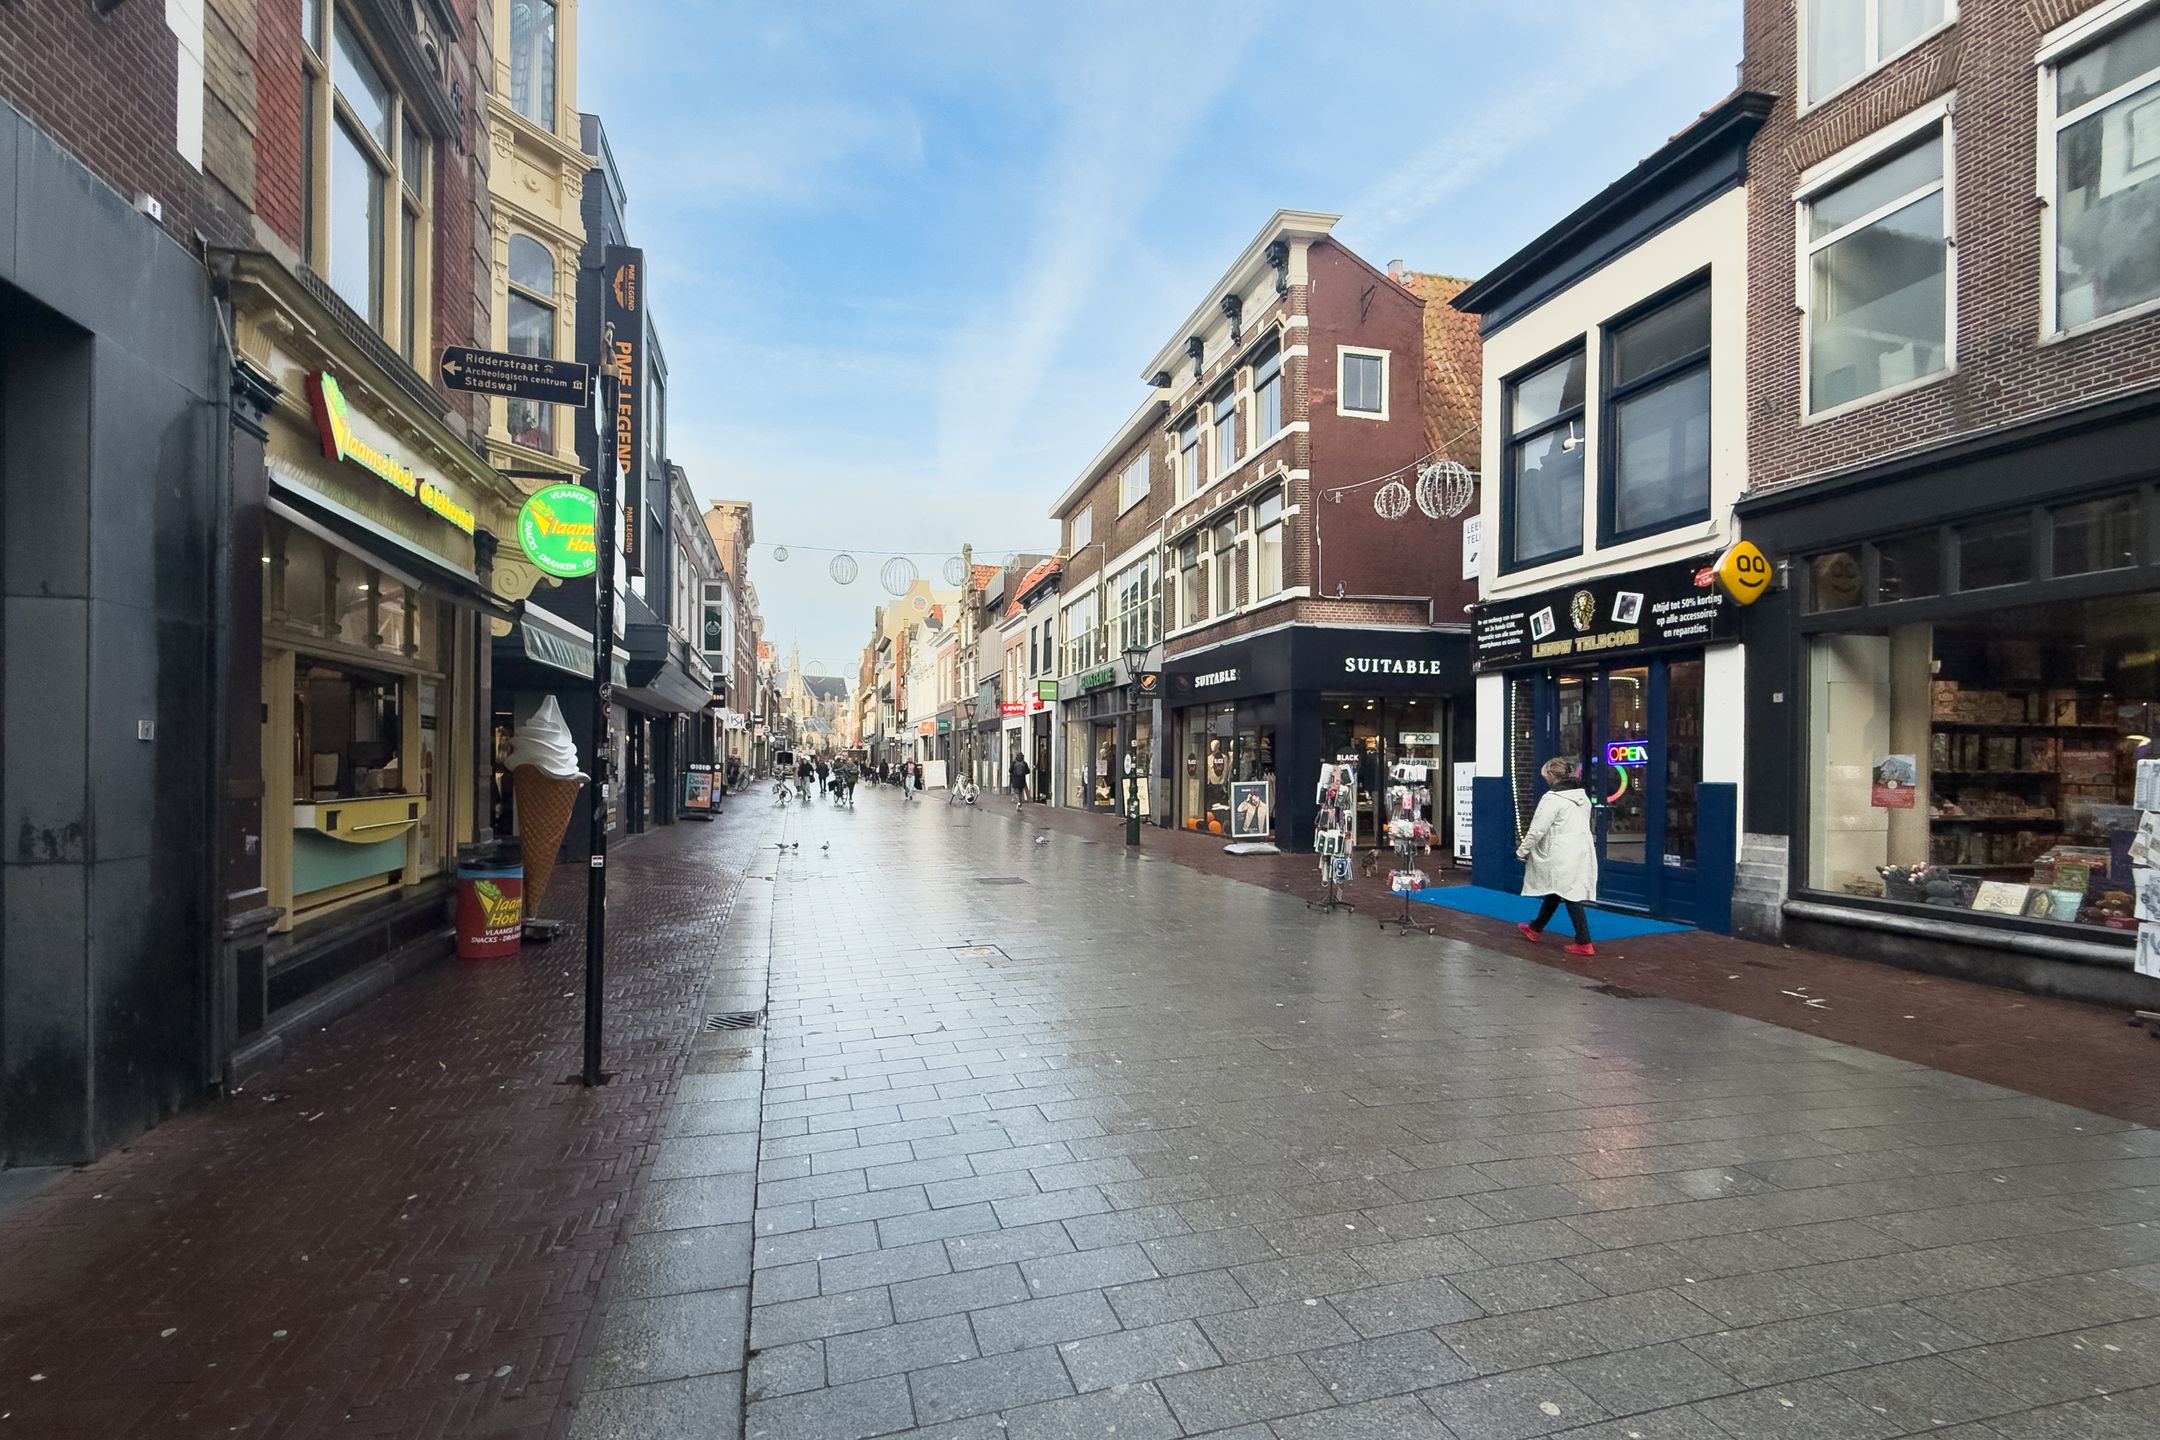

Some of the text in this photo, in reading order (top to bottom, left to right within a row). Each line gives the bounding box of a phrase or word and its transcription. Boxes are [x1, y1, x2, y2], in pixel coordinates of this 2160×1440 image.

[628, 264, 637, 311] PME LEGEND
[465, 353, 539, 372] Ridderstraat
[615, 340, 632, 386] PME
[464, 377, 517, 392] Stadswal
[465, 366, 568, 388] Archeologisch centrum
[550, 491, 590, 502] VLAAMSE
[525, 519, 539, 551] SNACKS
[538, 553, 578, 571] DRANKEN
[566, 537, 597, 552] Hoe
[1652, 593, 1722, 614] Altijd tot 50% korting
[1656, 608, 1718, 627] op alle accessoires
[1663, 623, 1708, 638] en reparaties.
[1532, 639, 1573, 658] LEEUW
[1575, 629, 1640, 653] TELECOM
[1345, 657, 1441, 675] SUITABLE
[1194, 669, 1237, 688] SUITABLE
[1609, 746, 1649, 762] OPEN
[471, 936, 497, 944] SNACKS
[485, 927, 514, 936] VLAAMSE
